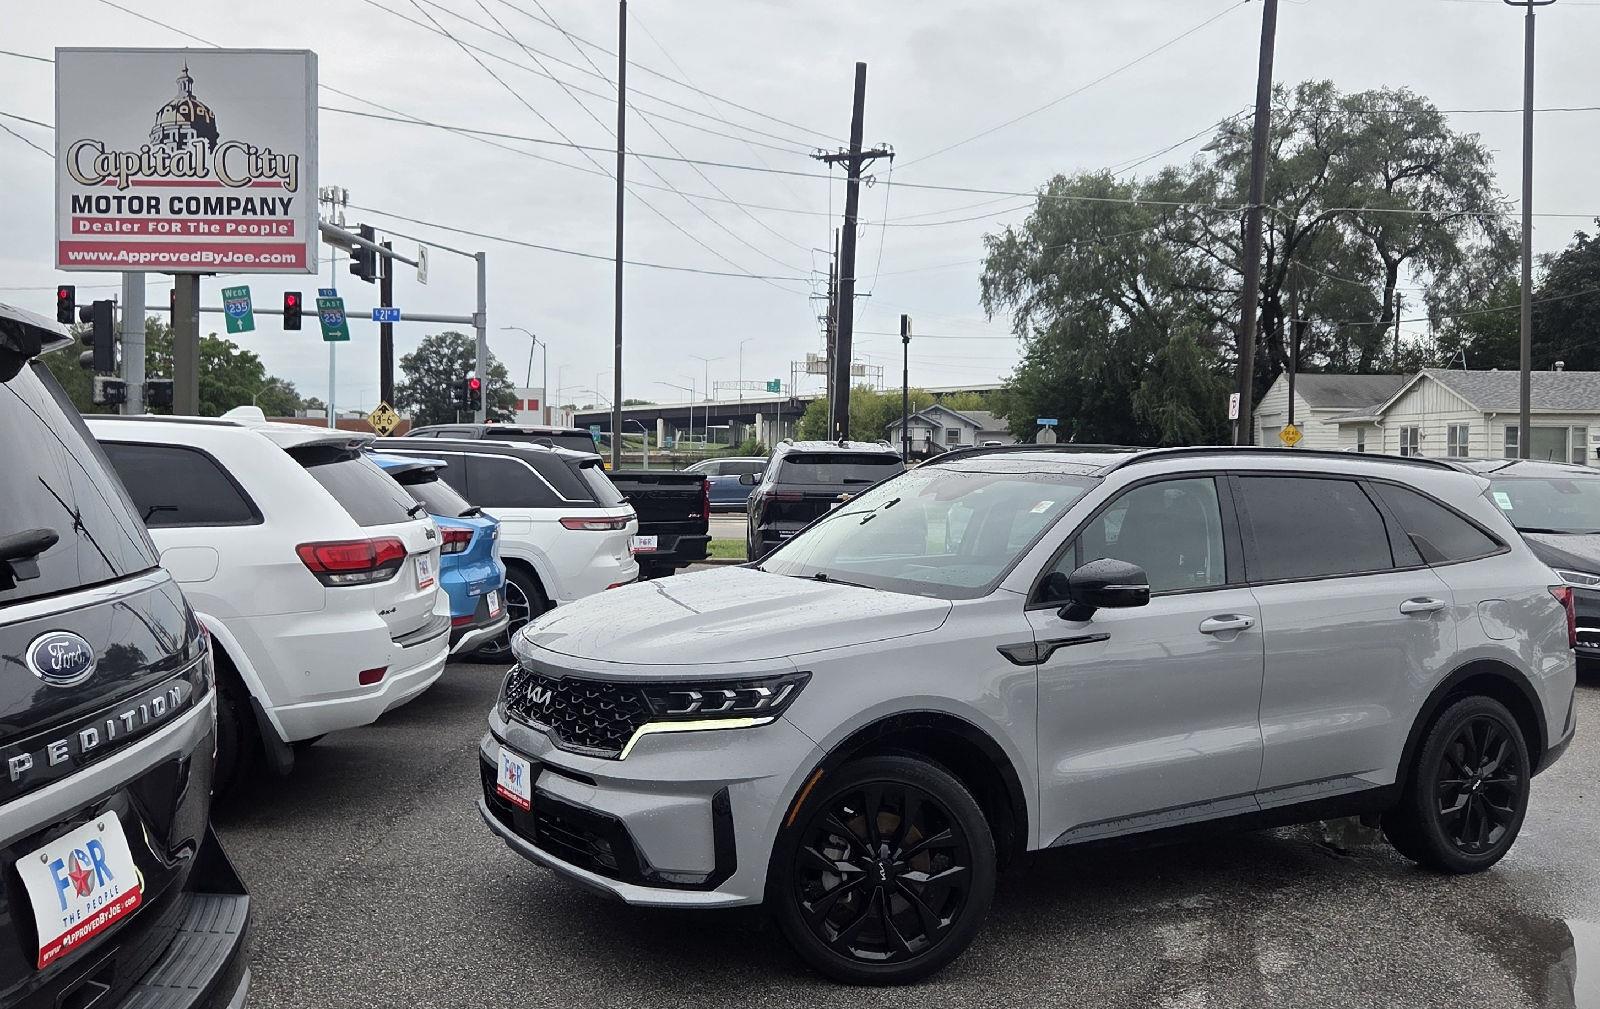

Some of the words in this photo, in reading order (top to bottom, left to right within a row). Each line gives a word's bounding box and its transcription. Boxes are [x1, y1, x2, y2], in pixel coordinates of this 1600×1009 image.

[67, 138, 210, 191] Capital
[214, 140, 299, 193] City
[71, 194, 161, 215] MOTOR
[169, 195, 294, 216] COMPANY
[79, 220, 141, 232] Dealer
[148, 222, 182, 233] FOR
[187, 222, 220, 233] The
[226, 222, 289, 236] People
[68, 250, 296, 264] www.ApprovedByJoe.com
[229, 301, 248, 314] 235
[323, 312, 342, 323] 235
[47, 640, 86, 670] Ford
[7, 686, 182, 782] PEDITION
[47, 838, 114, 912] FOR
[62, 909, 81, 928] THE
[86, 884, 119, 914] PEOPLE
